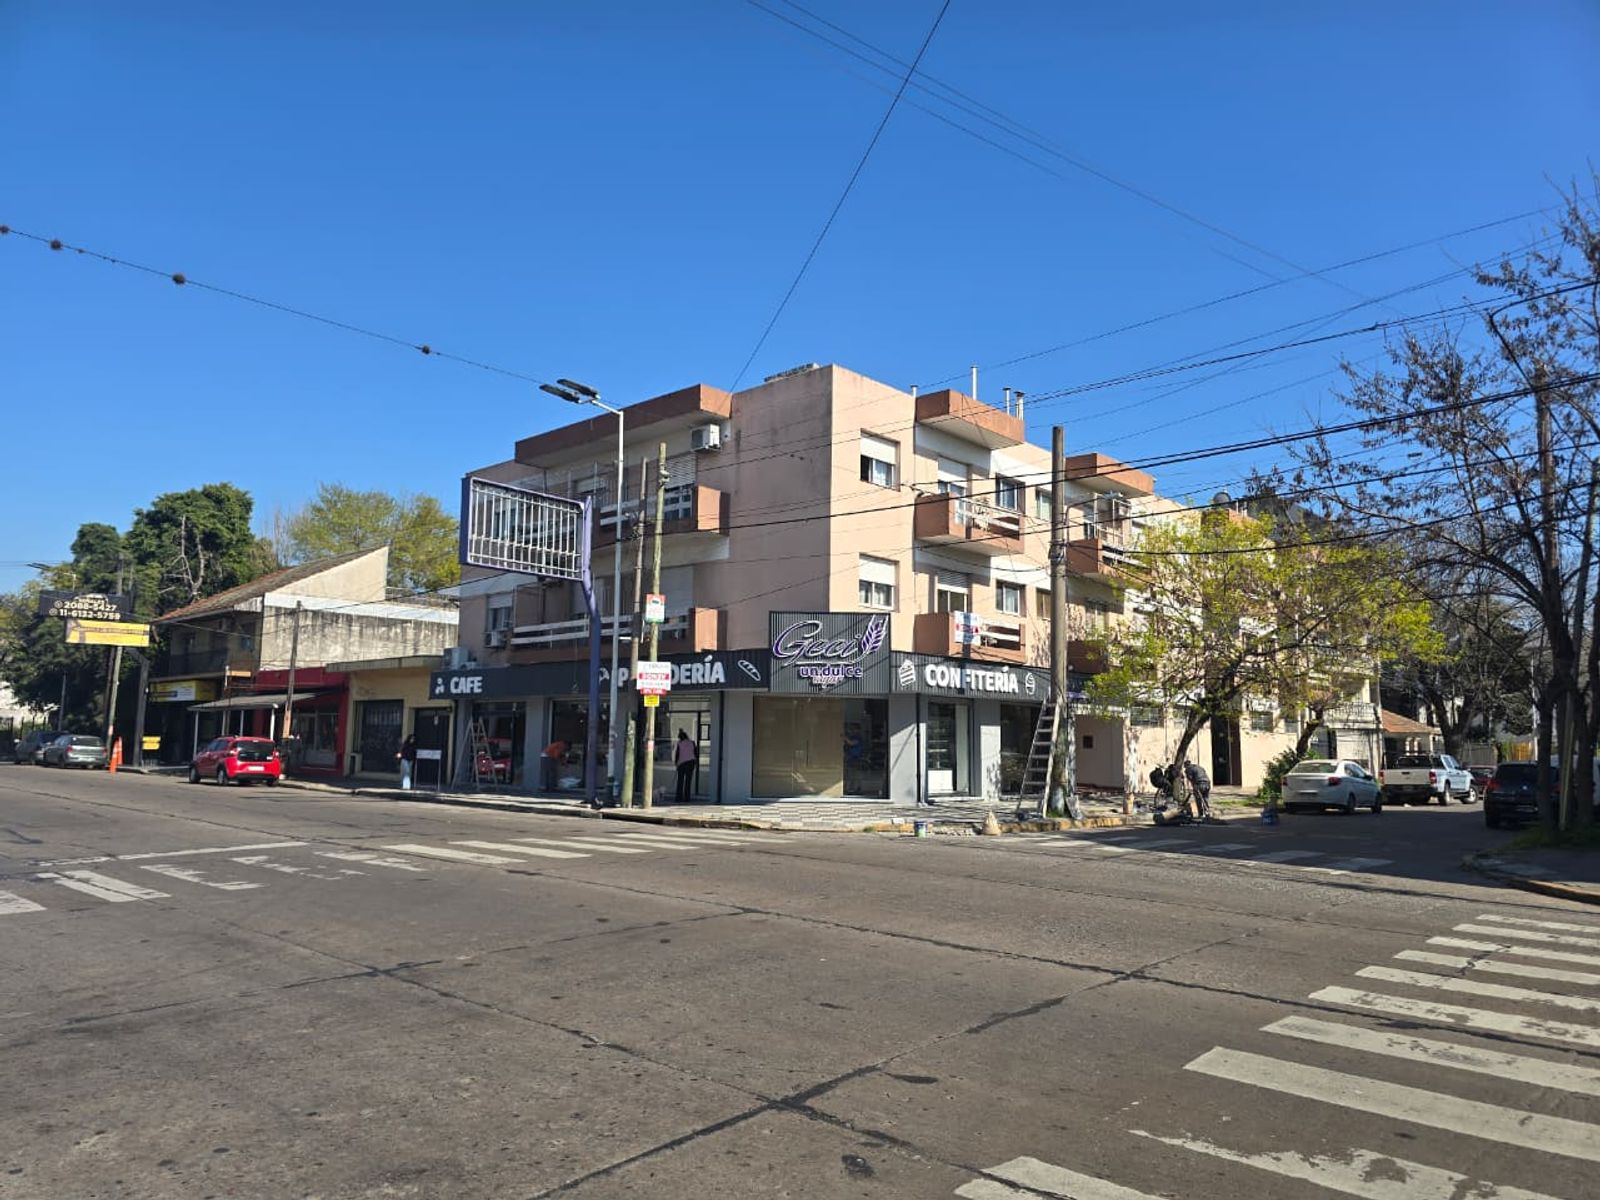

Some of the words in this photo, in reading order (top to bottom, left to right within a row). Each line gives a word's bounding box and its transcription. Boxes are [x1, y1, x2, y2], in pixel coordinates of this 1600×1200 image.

[618, 655, 725, 688] PDERÍA
[821, 663, 864, 678] dulce
[924, 663, 1019, 693] CONFITERÍA
[450, 676, 483, 694] CAFE
